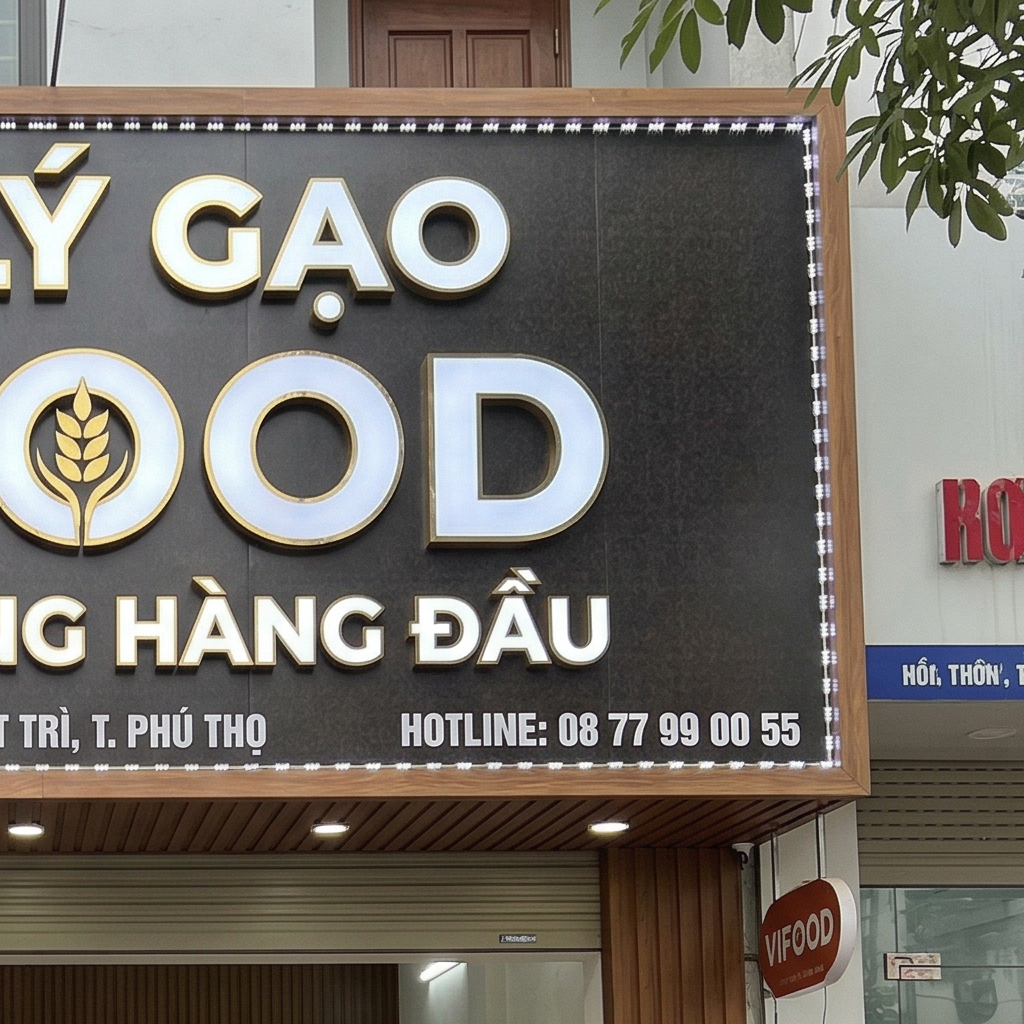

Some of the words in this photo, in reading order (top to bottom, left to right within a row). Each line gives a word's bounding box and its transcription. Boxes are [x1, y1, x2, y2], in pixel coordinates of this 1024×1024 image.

[151, 174, 511, 328] GẠO
[115, 575, 385, 668] HÀNG
[408, 567, 611, 668] ĐẦU
[19, 706, 80, 754] TRÌ,
[91, 714, 116, 749] T.
[127, 706, 193, 749] PHÚ
[204, 713, 267, 756] THỌ
[401, 712, 548, 747] HOTLINE:
[558, 712, 599, 747] 08
[607, 712, 649, 747] 77
[659, 712, 700, 747] 99
[709, 712, 751, 747] 00
[761, 712, 801, 747] 55
[764, 907, 834, 967] VIFOOD
